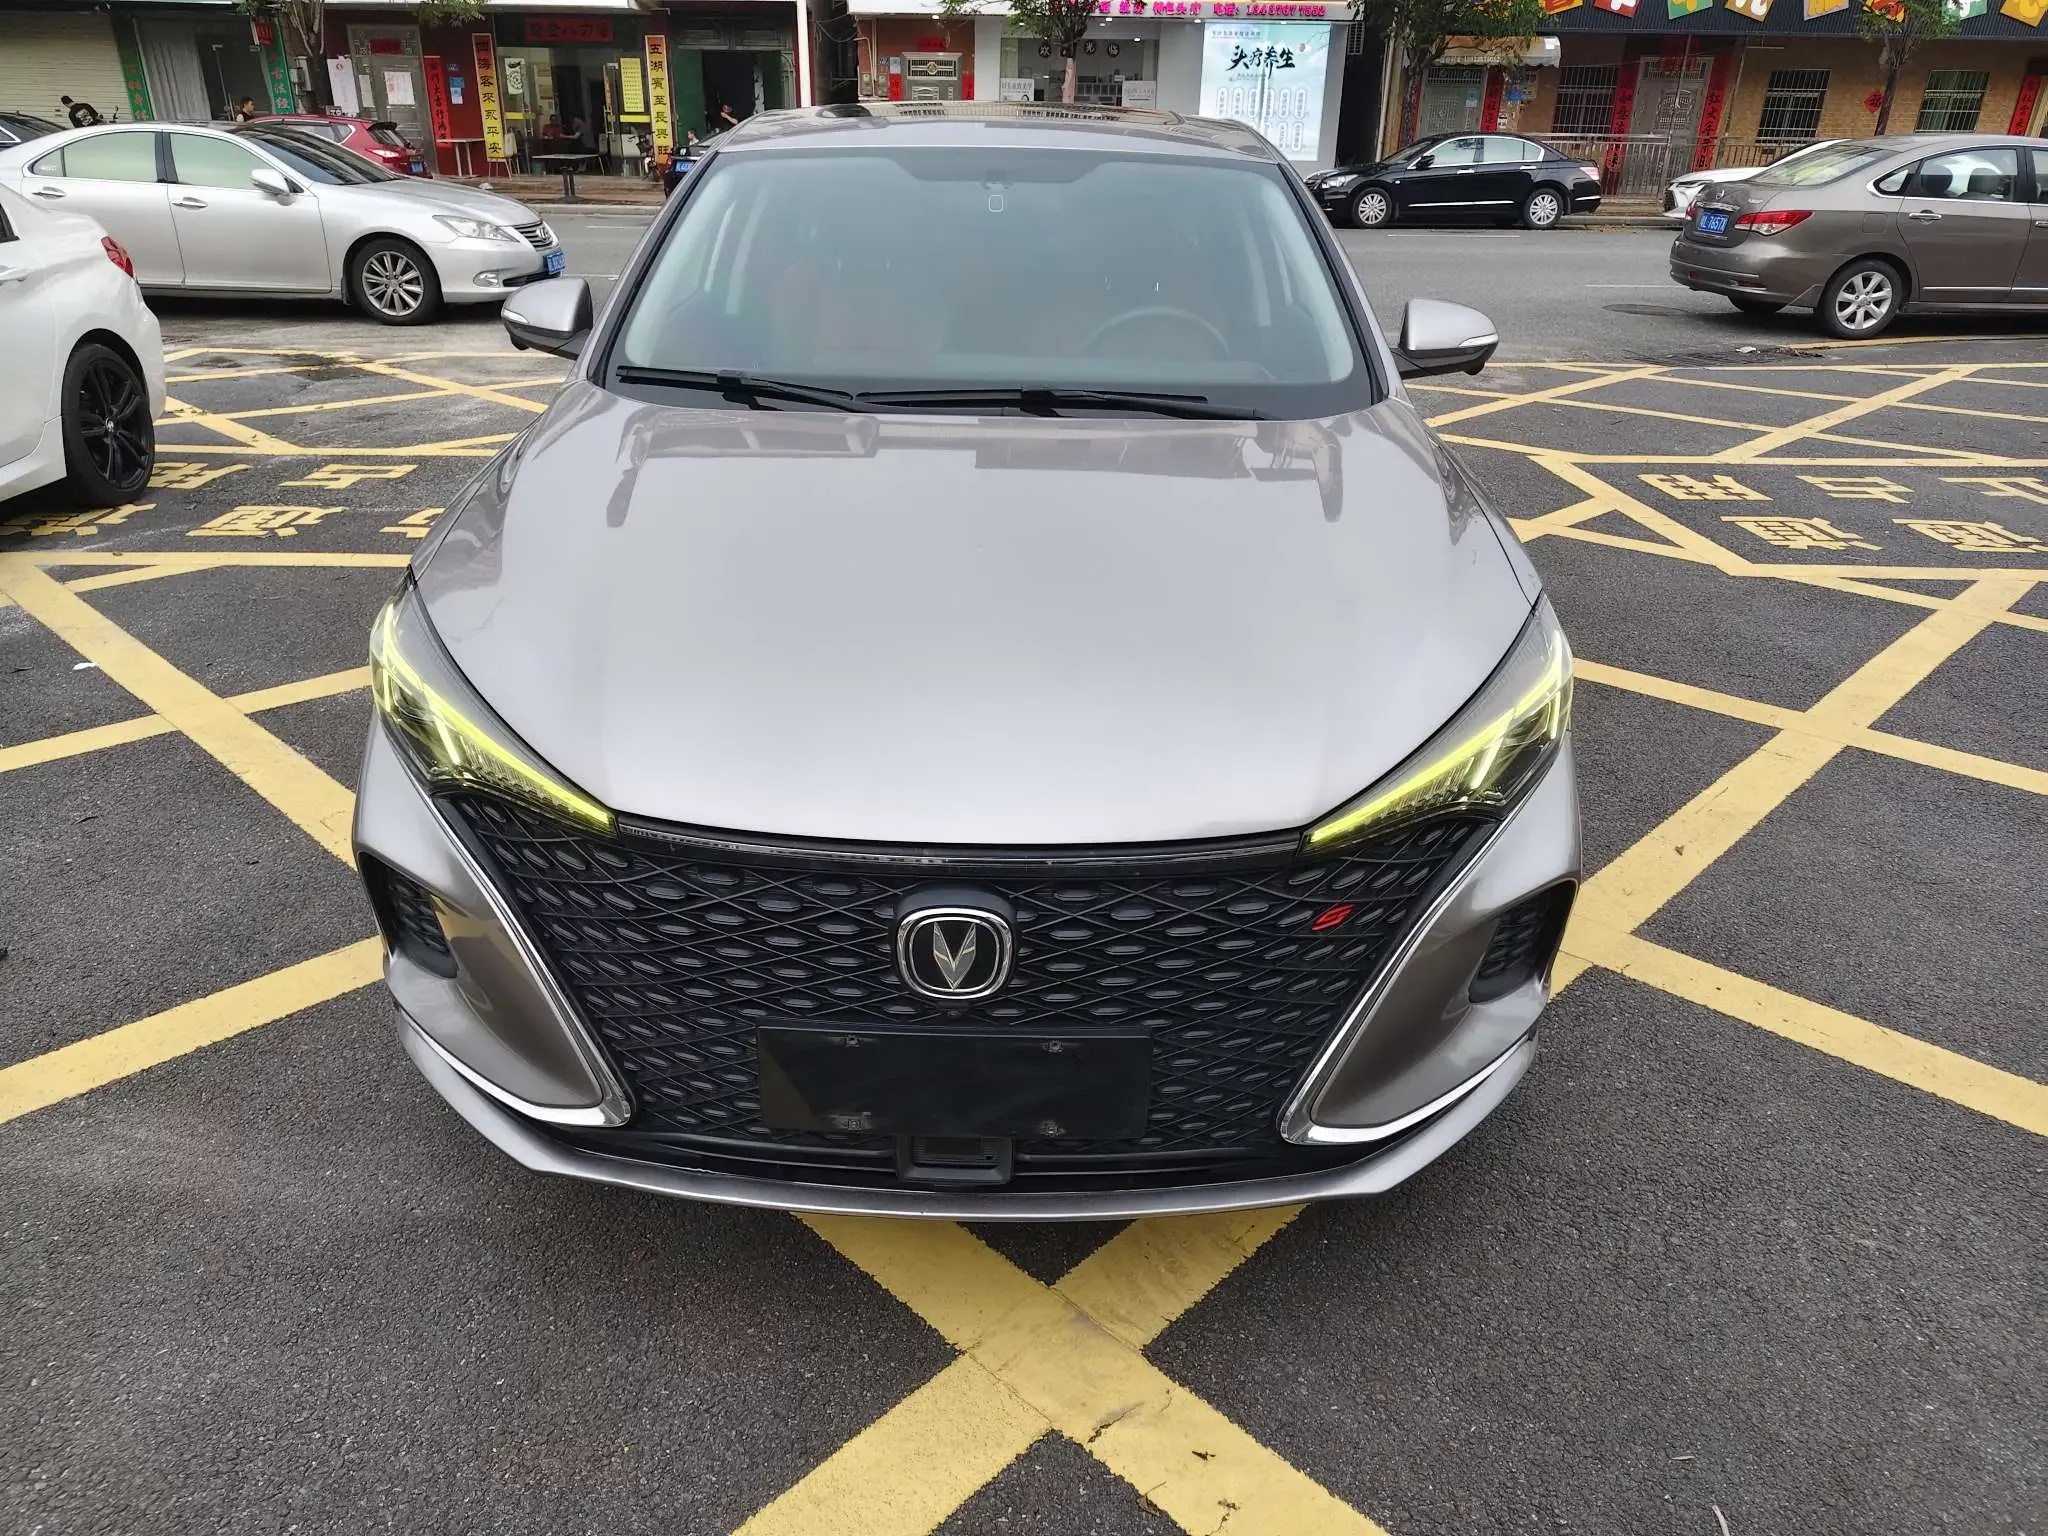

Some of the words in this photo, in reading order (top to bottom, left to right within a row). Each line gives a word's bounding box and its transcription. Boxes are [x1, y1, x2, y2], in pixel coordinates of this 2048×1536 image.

[1039, 40, 1120, 57] 欢光临
[1225, 45, 1297, 79] 头疗养生
